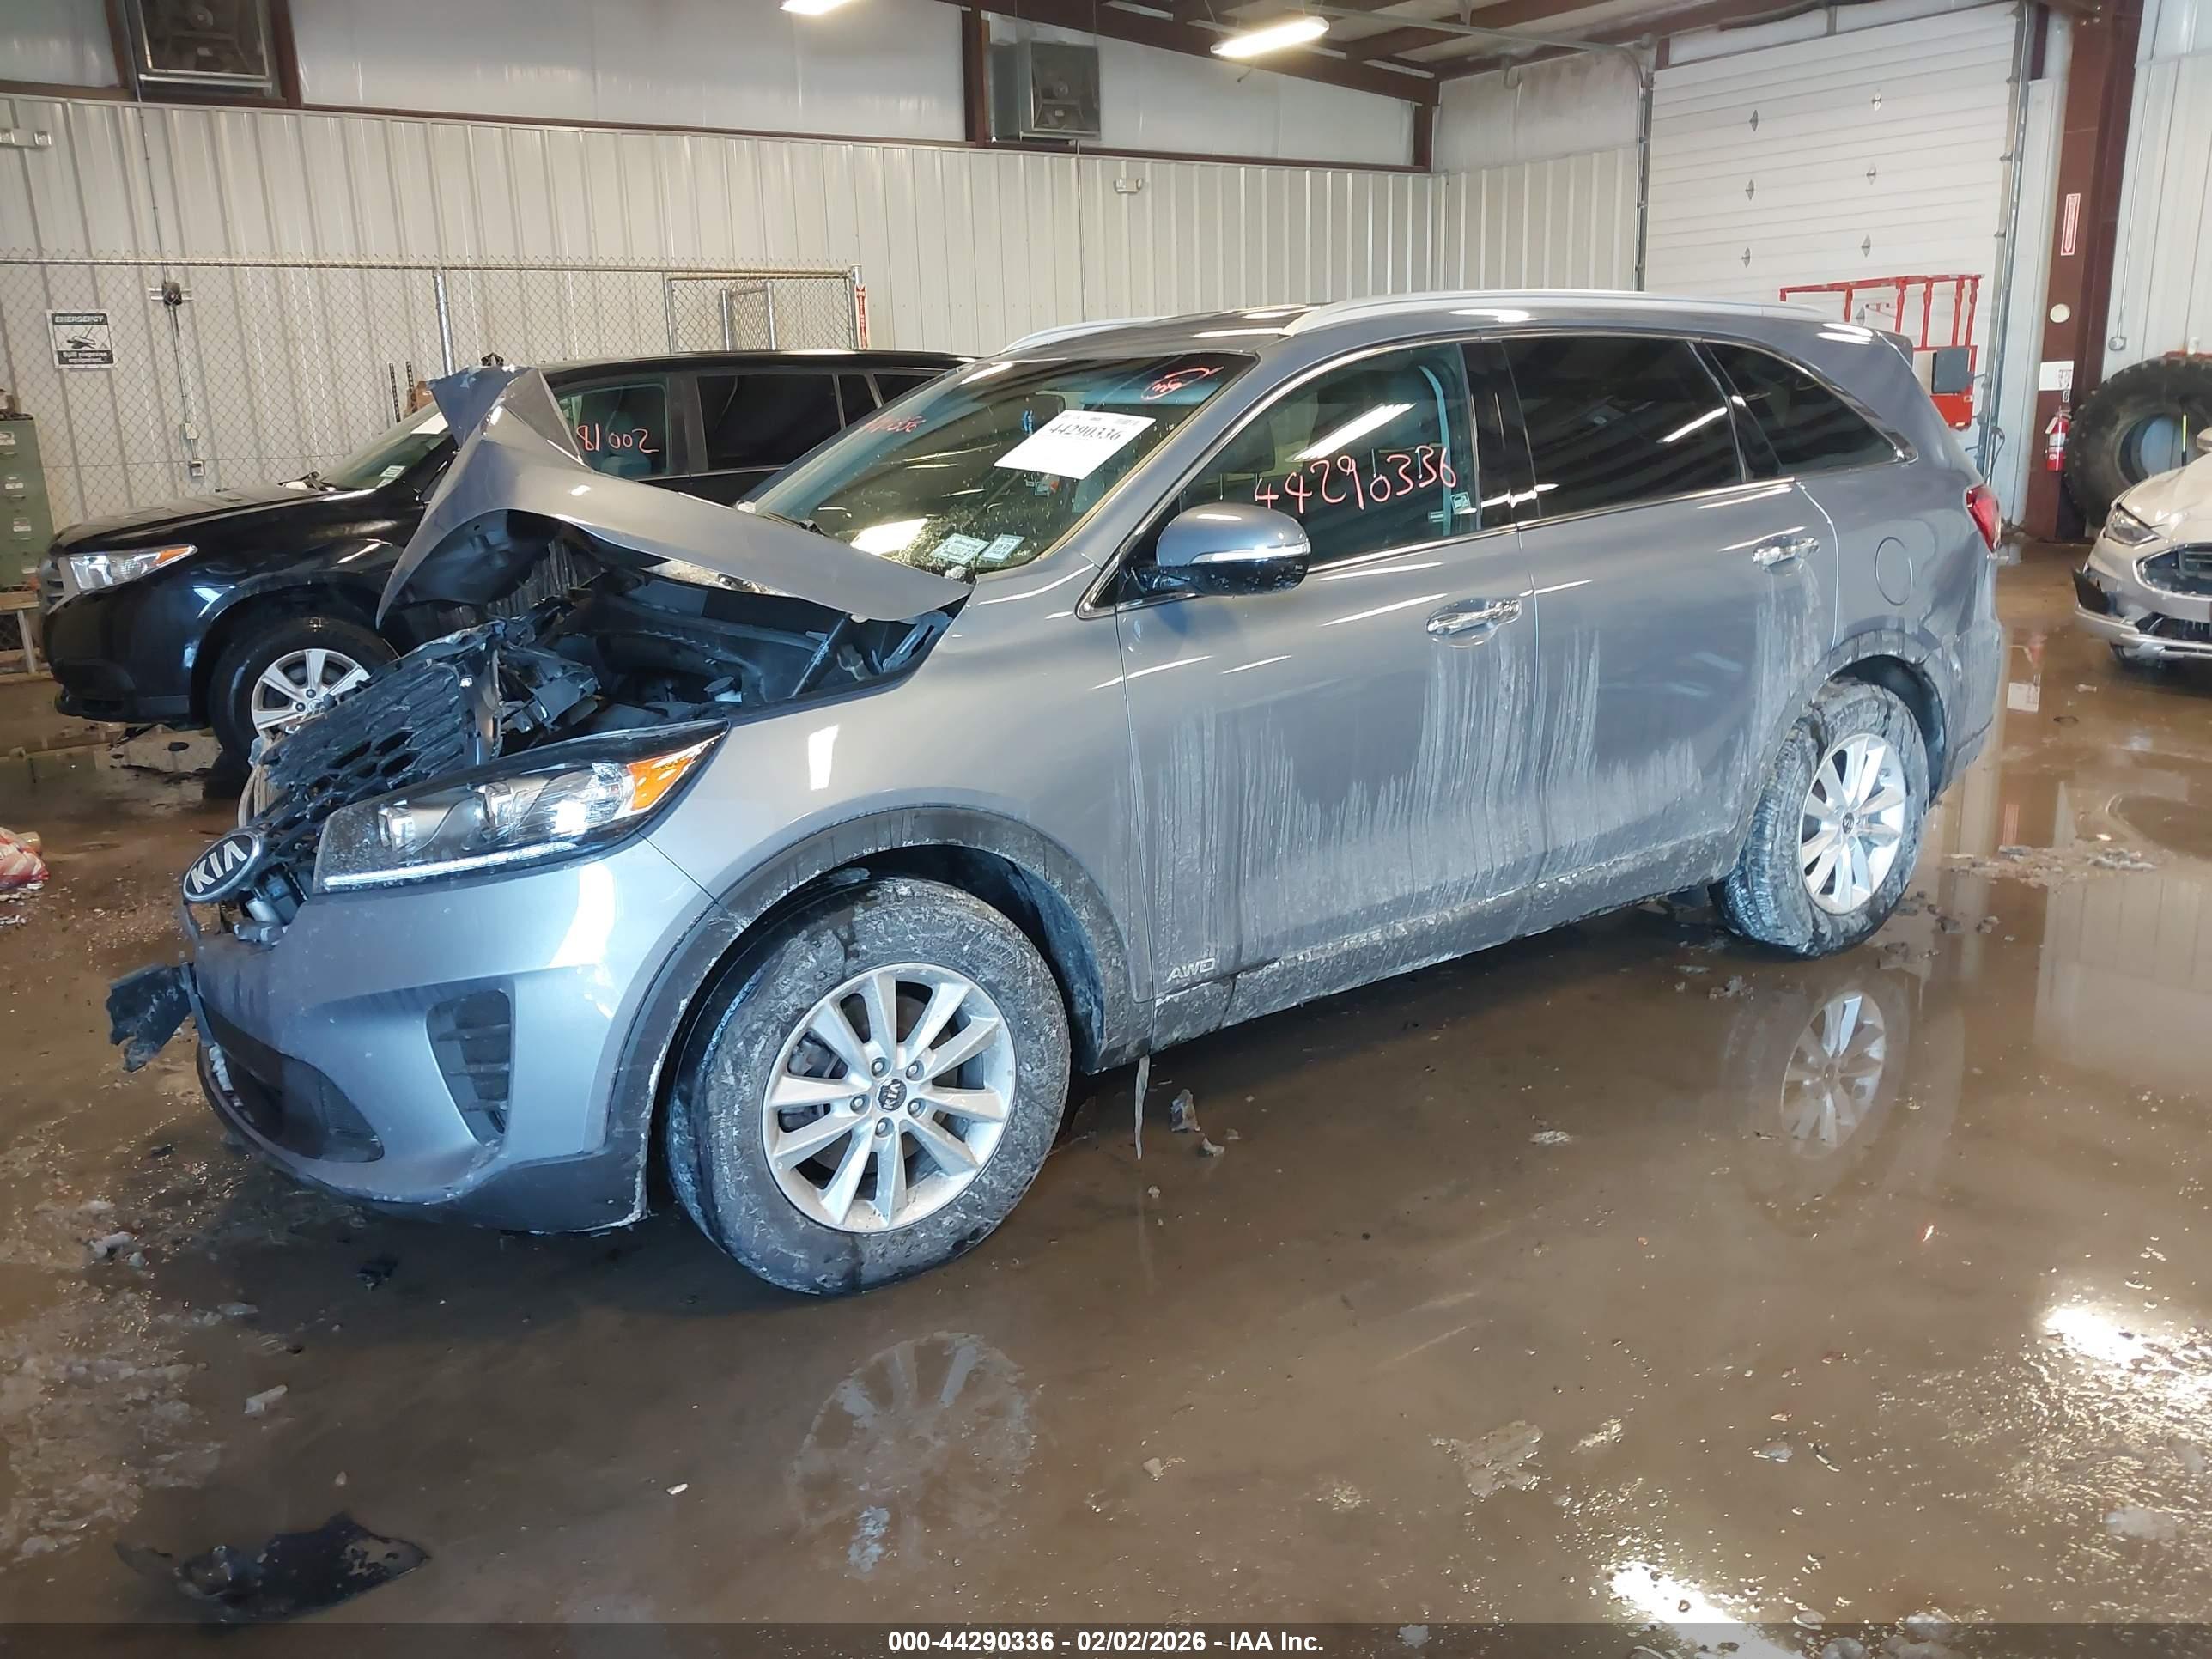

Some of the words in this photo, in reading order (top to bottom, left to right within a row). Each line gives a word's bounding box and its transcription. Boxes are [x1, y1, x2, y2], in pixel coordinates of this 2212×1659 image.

[1049, 423, 1122, 441] 44290336
[1254, 445, 1456, 514] 44290336
[191, 841, 248, 893] KIA
[1166, 957, 1216, 982] AWD
[884, 1083, 901, 1109] KIA
